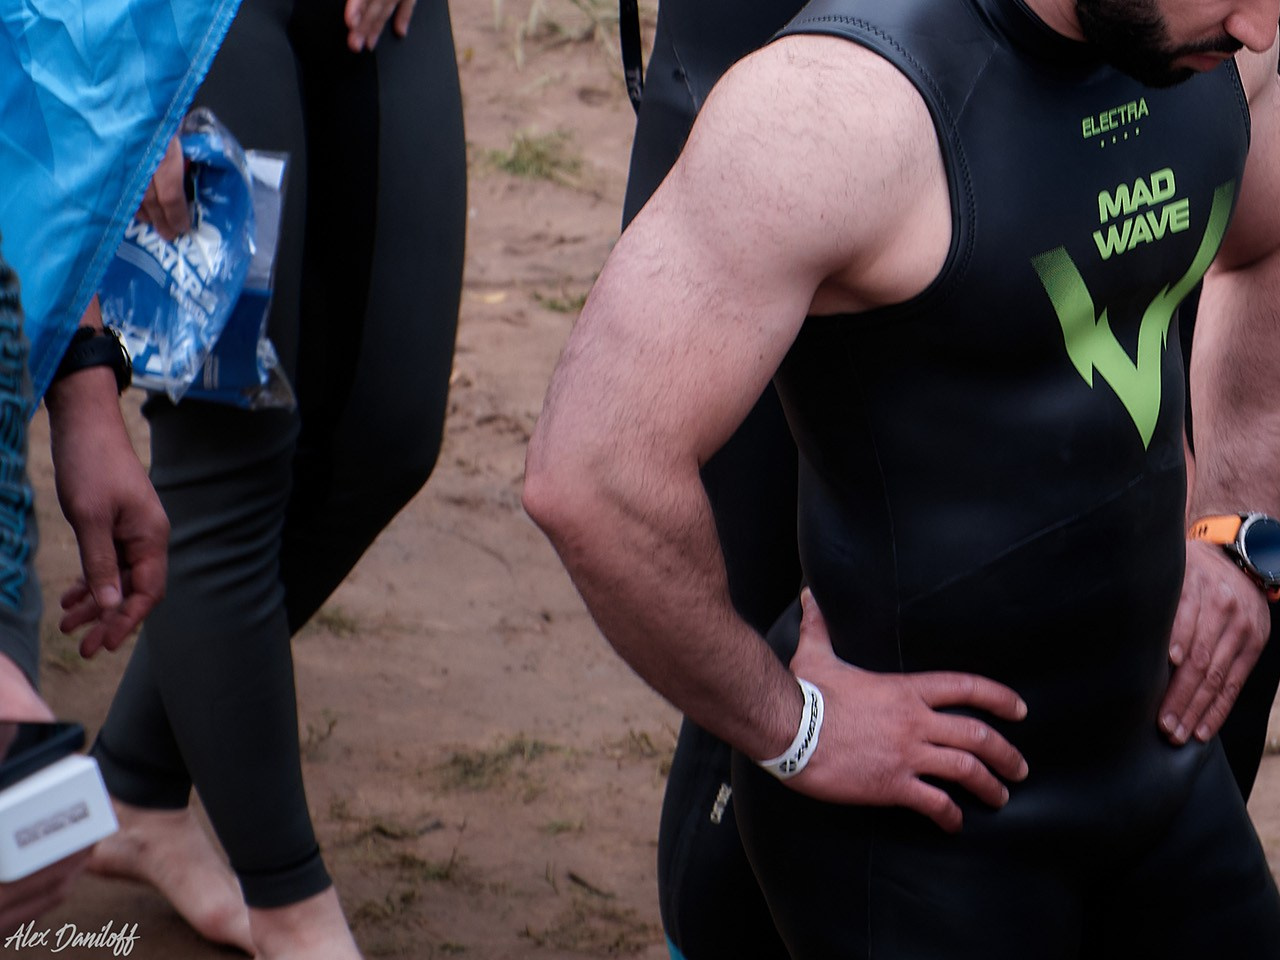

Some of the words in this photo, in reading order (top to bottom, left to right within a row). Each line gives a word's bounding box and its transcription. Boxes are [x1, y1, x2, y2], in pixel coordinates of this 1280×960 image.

[1082, 97, 1149, 139] ELECTRA
[1098, 167, 1177, 224] MAD
[1093, 197, 1190, 261] WAVE
